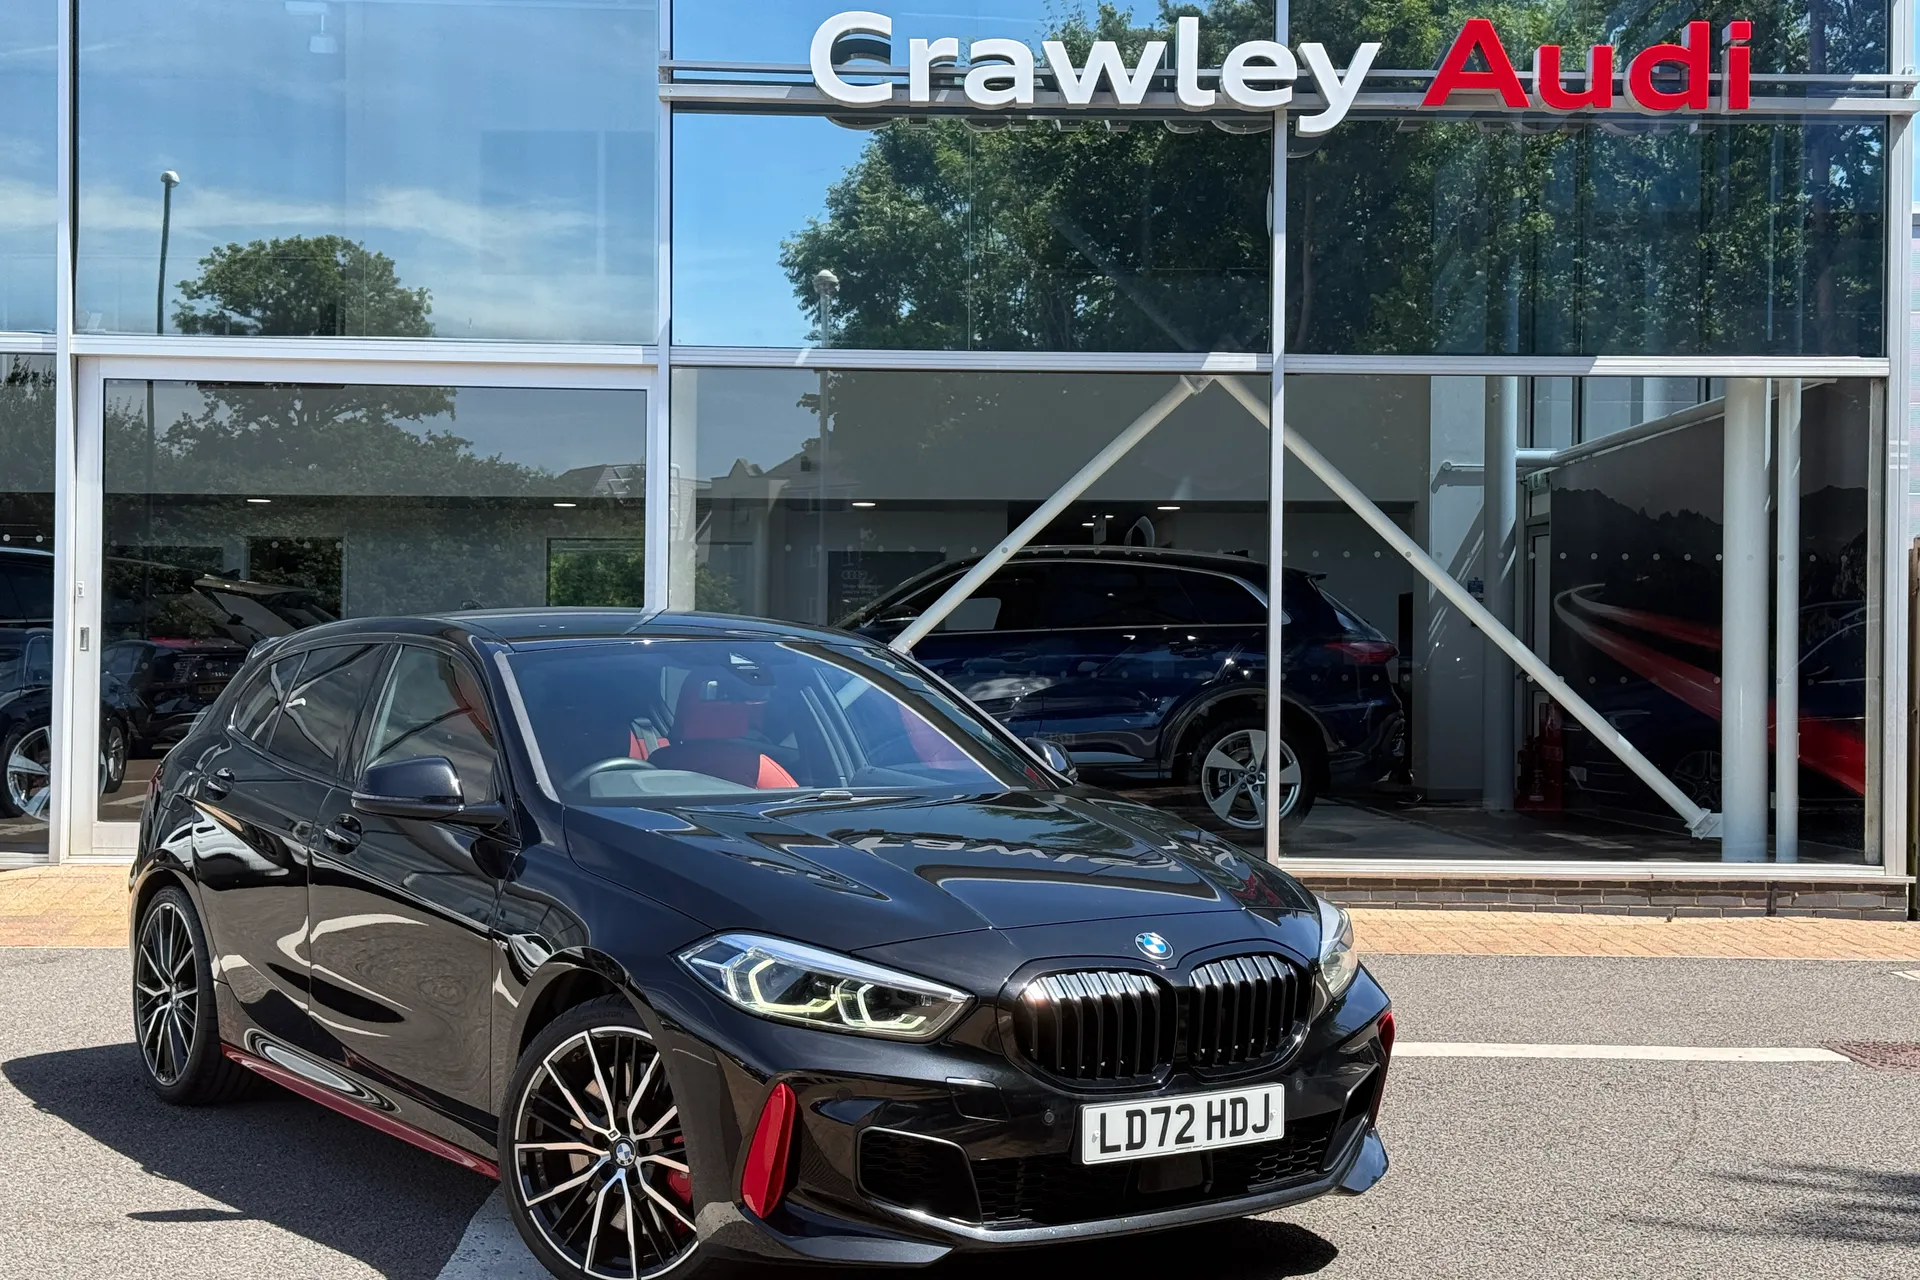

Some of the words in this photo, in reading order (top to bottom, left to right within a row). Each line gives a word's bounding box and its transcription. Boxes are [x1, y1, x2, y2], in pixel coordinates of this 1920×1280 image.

[810, 11, 1382, 134] Crawley
[1419, 18, 1752, 112] Audi
[1100, 1103, 1195, 1154] LD72
[1206, 1093, 1270, 1141] HDJ
